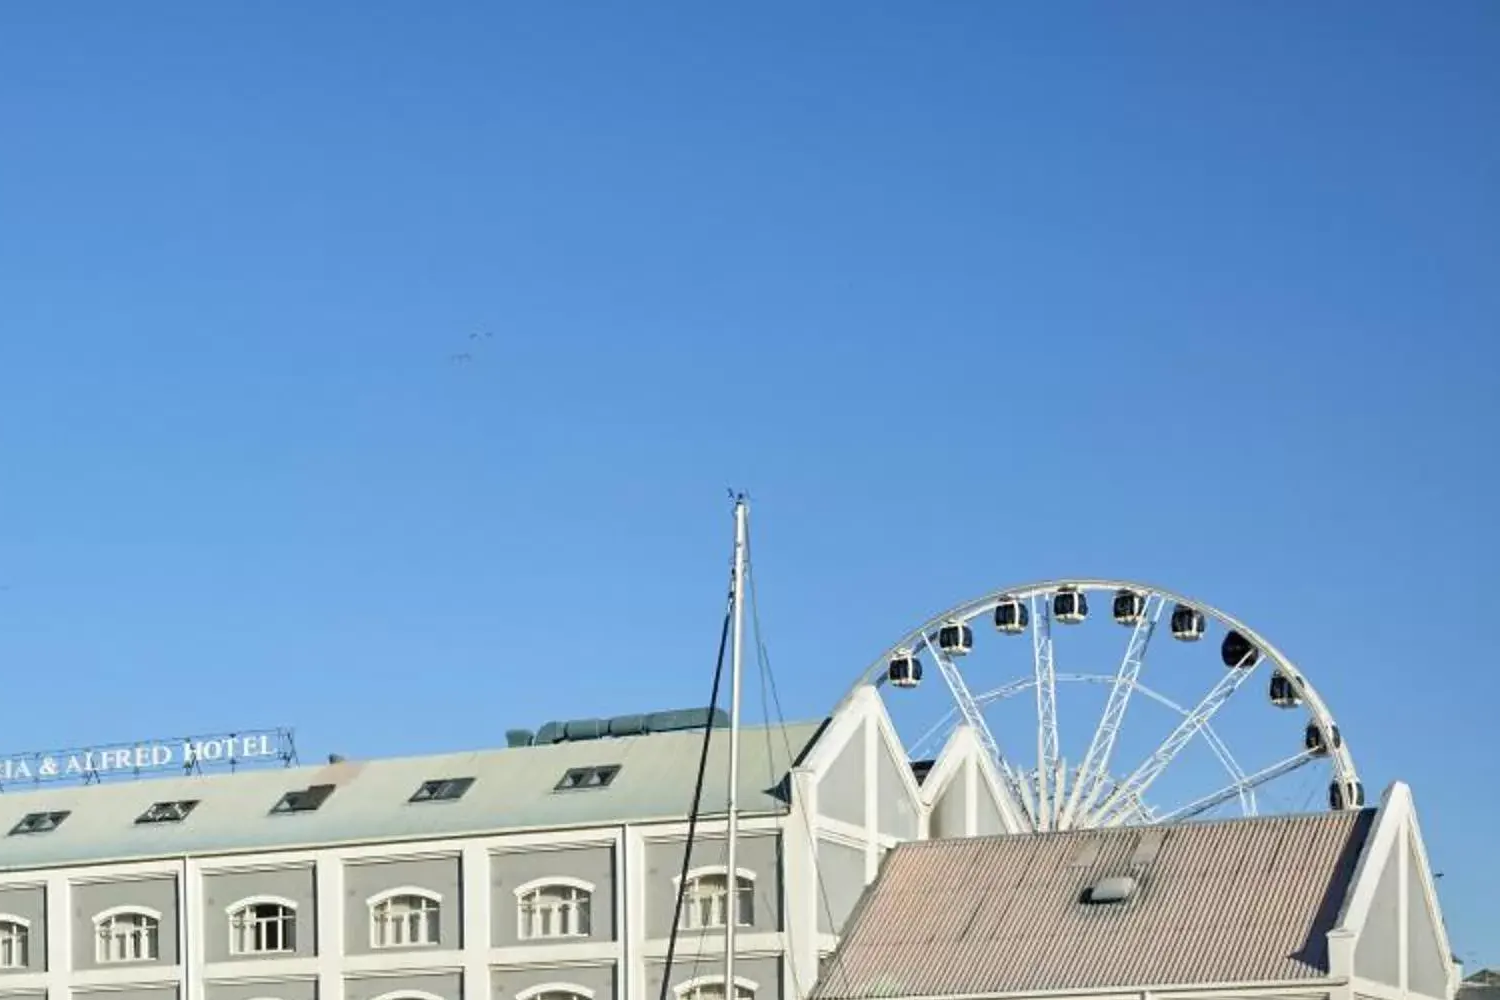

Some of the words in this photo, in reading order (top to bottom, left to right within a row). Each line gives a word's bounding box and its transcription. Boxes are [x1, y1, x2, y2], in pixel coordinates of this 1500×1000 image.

[39, 757, 59, 776] &
[65, 745, 173, 775] ALFRED
[182, 735, 275, 762] HOTEL
